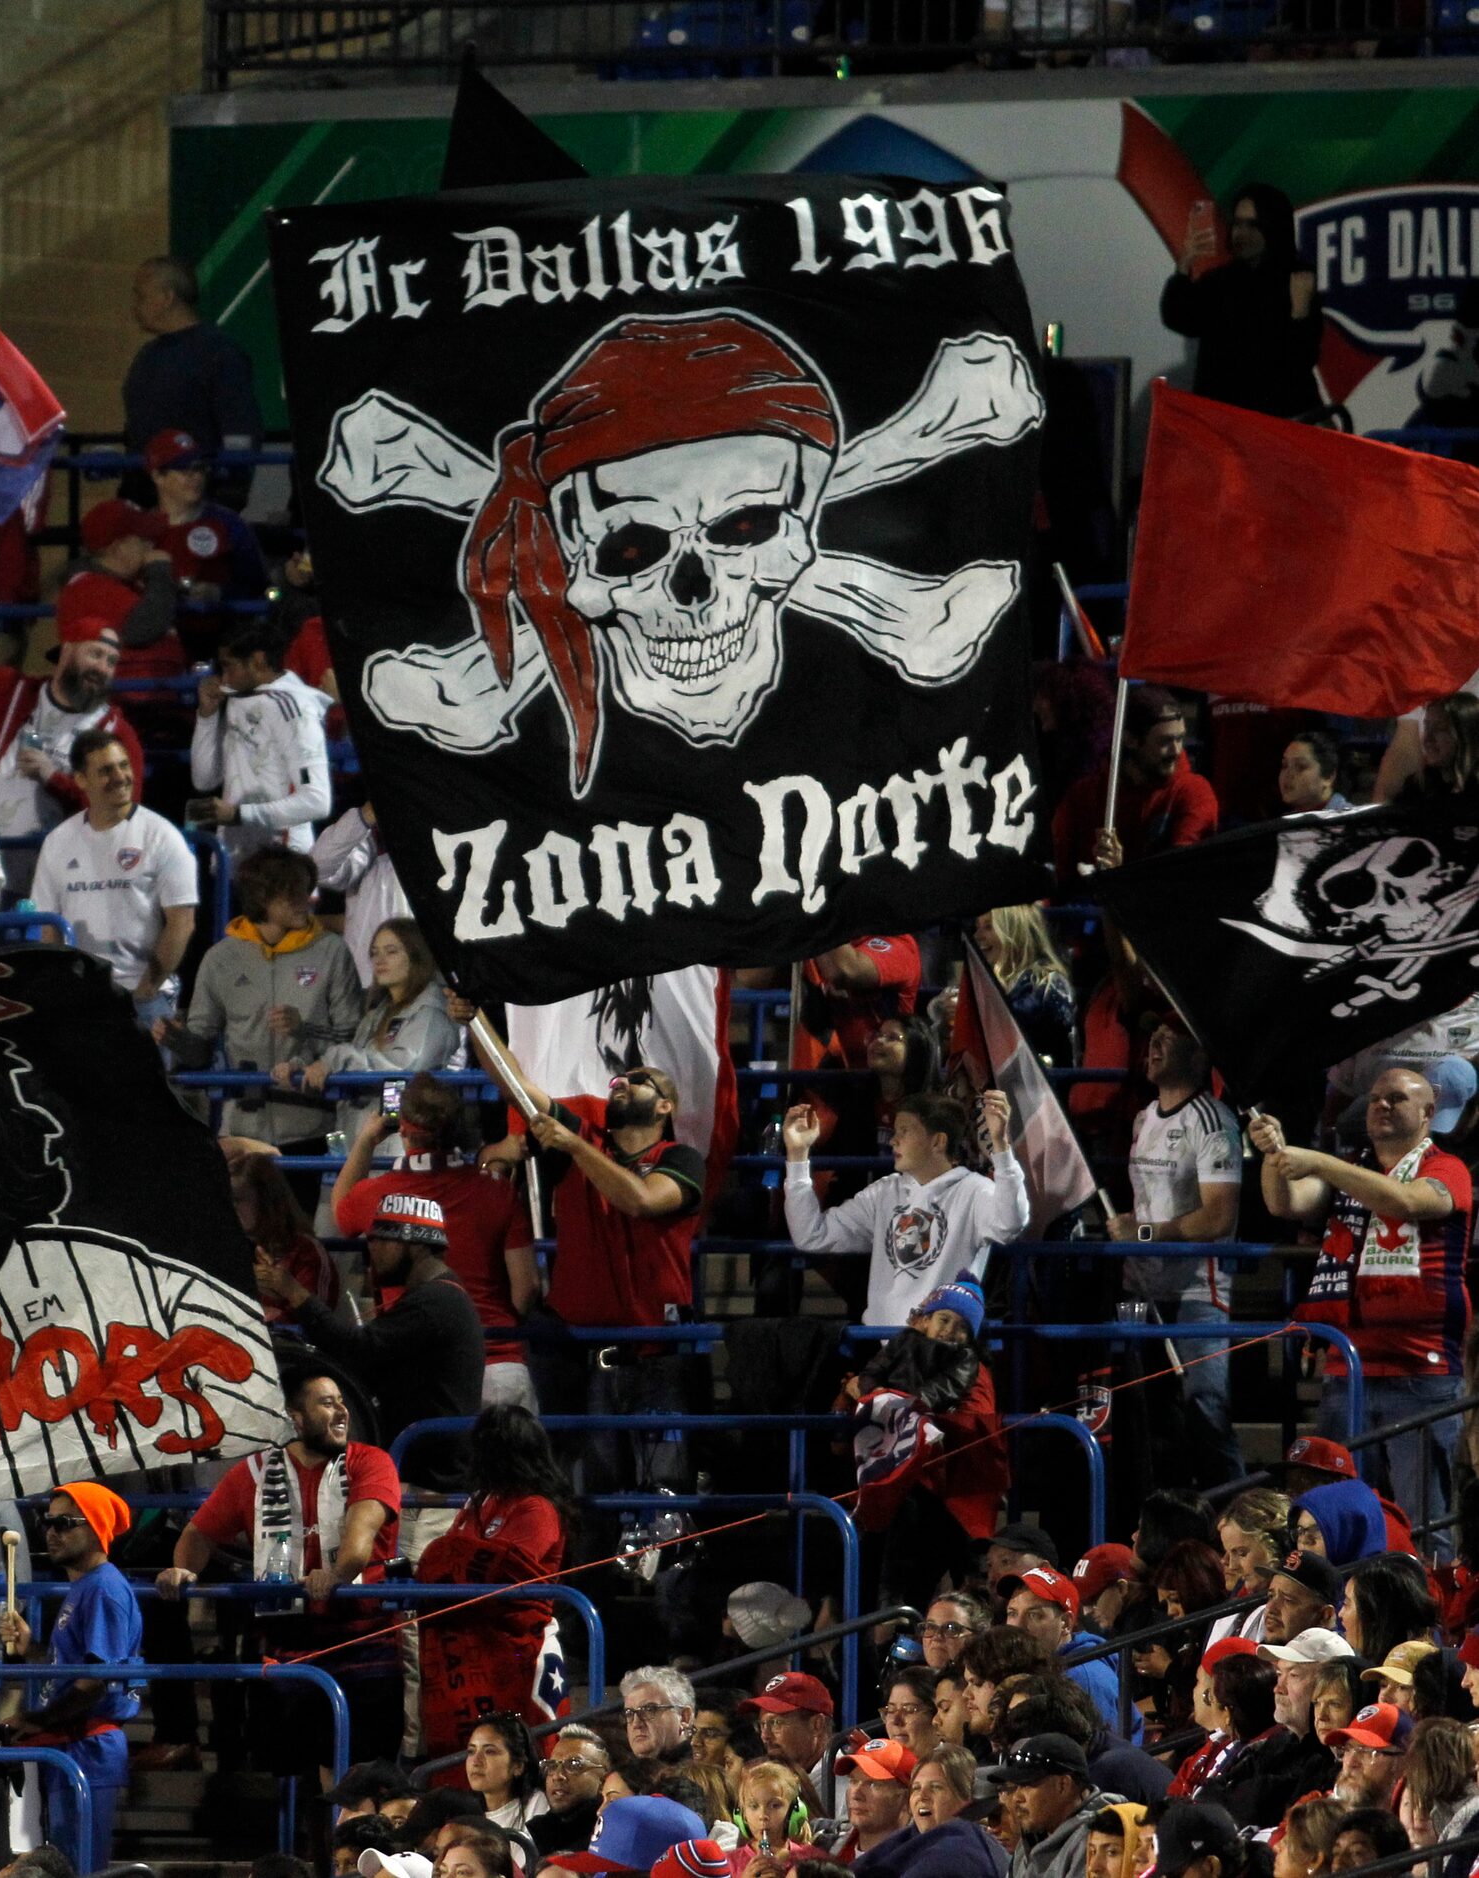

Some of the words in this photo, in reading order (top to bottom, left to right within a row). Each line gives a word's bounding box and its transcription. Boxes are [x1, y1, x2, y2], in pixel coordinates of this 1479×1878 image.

[452, 210, 745, 314] Dallas
[785, 187, 1011, 274] 1996
[1317, 215, 1366, 292] FC
[1408, 294, 1455, 311] 96
[432, 812, 722, 942] Zona
[743, 736, 1037, 914] Norte
[66, 878, 132, 893] ADVOCARE
[1364, 1256, 1414, 1265] BURN
[23, 1293, 64, 1322] EM
